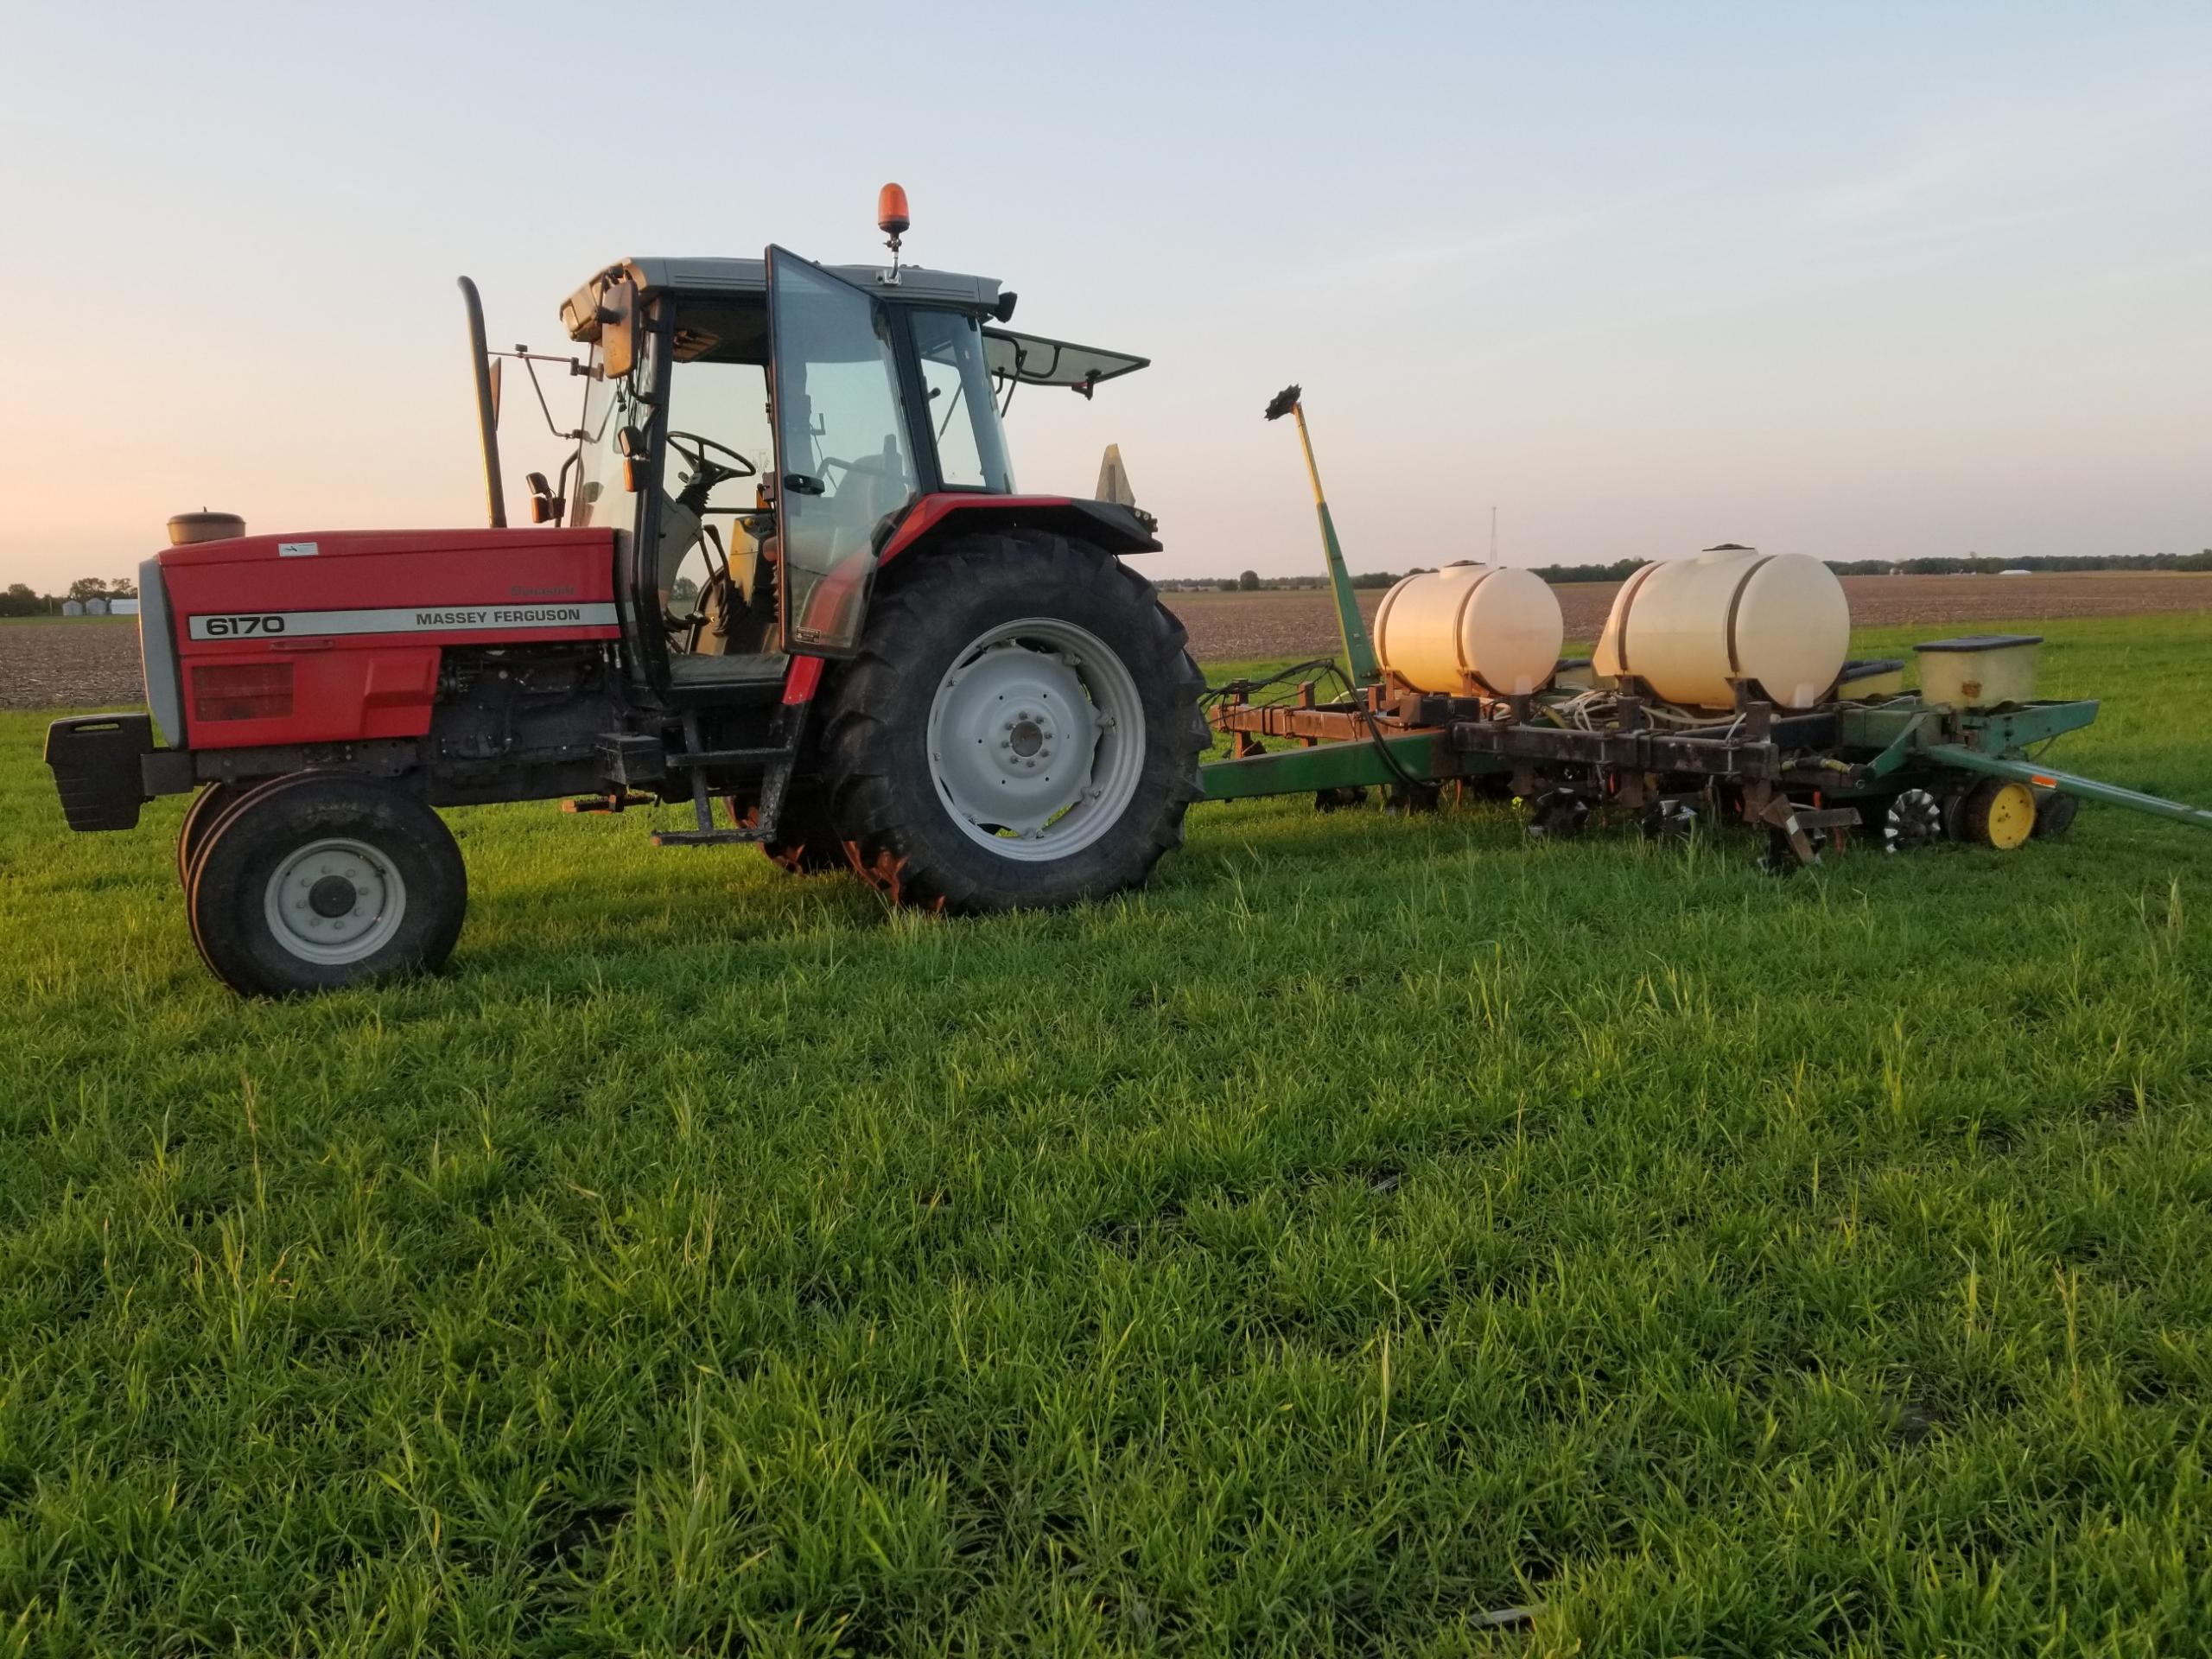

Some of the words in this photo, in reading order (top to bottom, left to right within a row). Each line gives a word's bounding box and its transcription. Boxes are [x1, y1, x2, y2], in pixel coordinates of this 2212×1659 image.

[207, 616, 284, 635] 6170
[416, 612, 486, 626] MASSEY
[494, 609, 581, 622] FERGUSON
